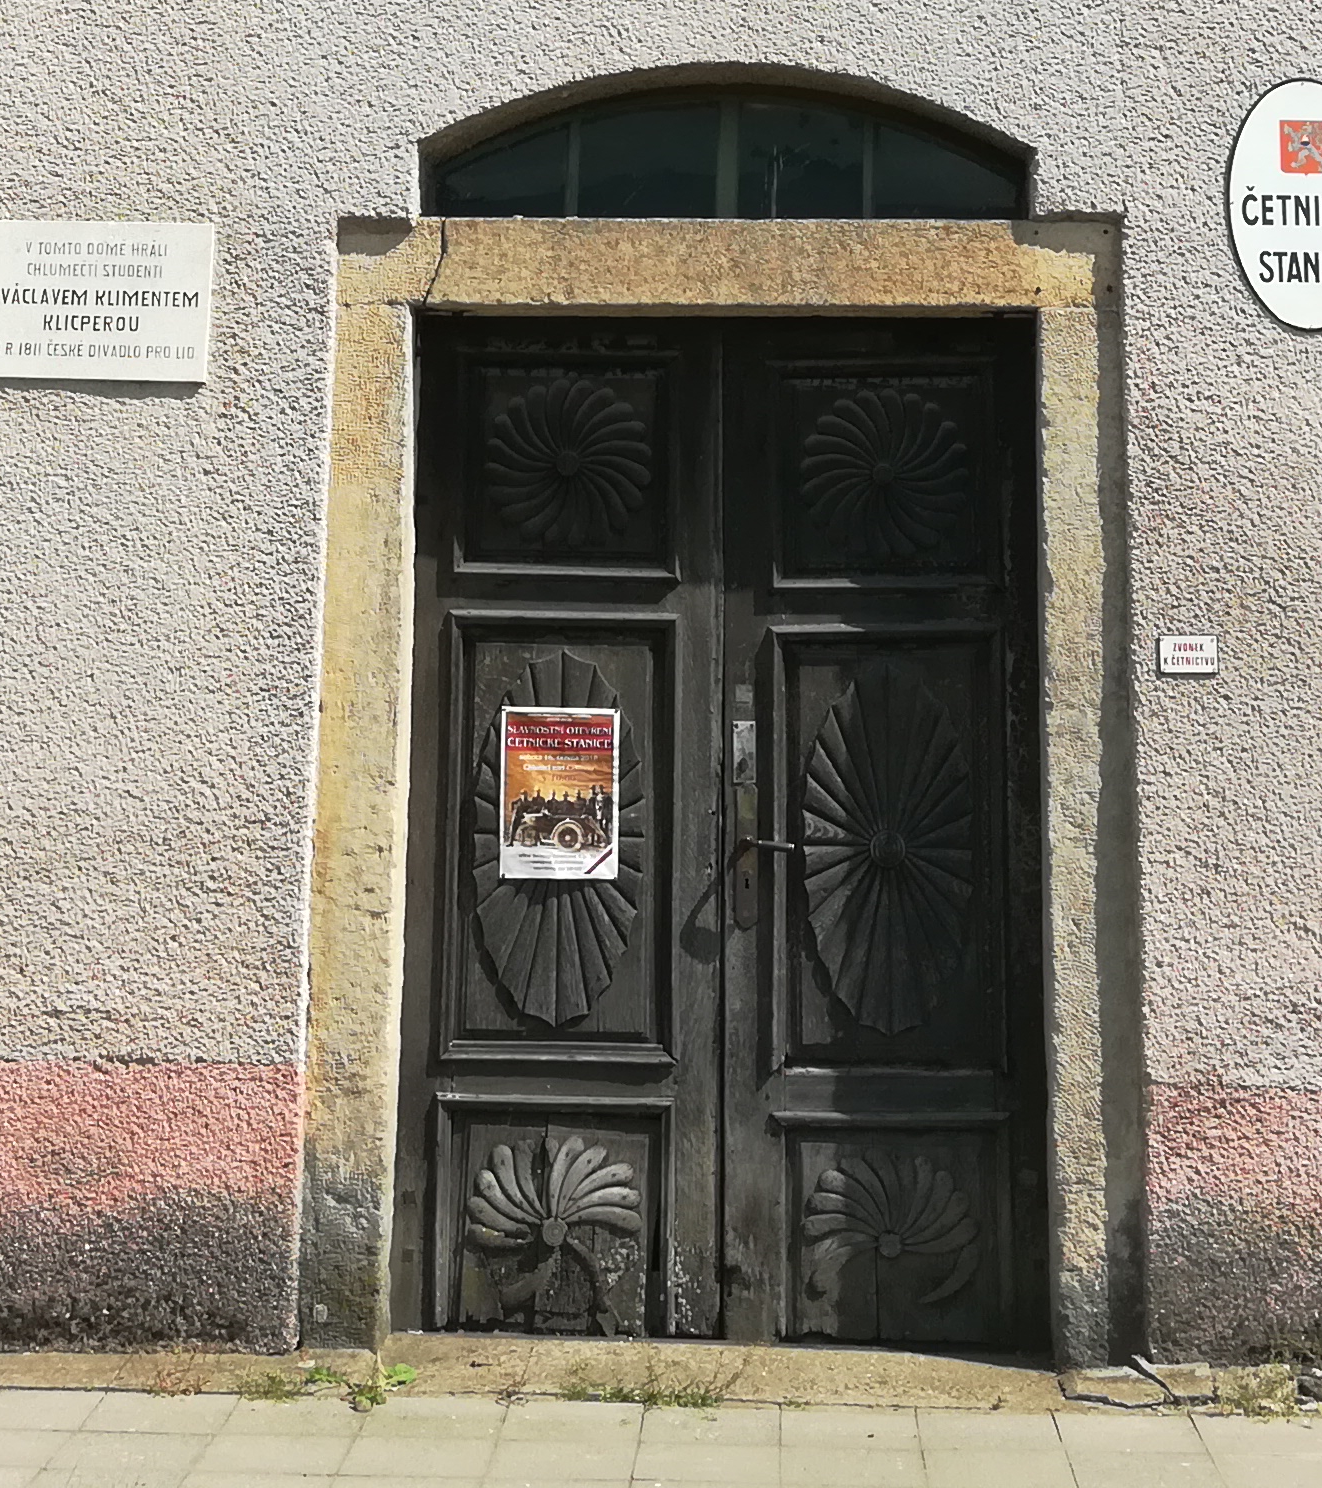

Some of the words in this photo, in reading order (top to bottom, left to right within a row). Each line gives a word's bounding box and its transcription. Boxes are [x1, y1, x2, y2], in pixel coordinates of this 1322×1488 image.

[26, 241, 33, 254] V
[38, 241, 82, 255] TOMTO
[131, 239, 168, 257] HRÁLI
[27, 259, 98, 278] CHLUMEČTÍ
[102, 263, 163, 279] STUDENTI
[1, 282, 88, 306] VÁCLAVEM
[95, 289, 199, 308] KLIMENTEM
[43, 314, 139, 332] KLICPEROU
[18, 342, 42, 356] 1811
[47, 338, 84, 357] ČESKÉ
[88, 344, 141, 359] DIVADLO
[146, 345, 171, 359] PRO
[176, 346, 195, 360] LID
[1173, 642, 1204, 652] ZVONEK
[1163, 657, 1169, 665] K
[1171, 654, 1215, 666] ČETNICTVU
[564, 738, 612, 749] STANICE
